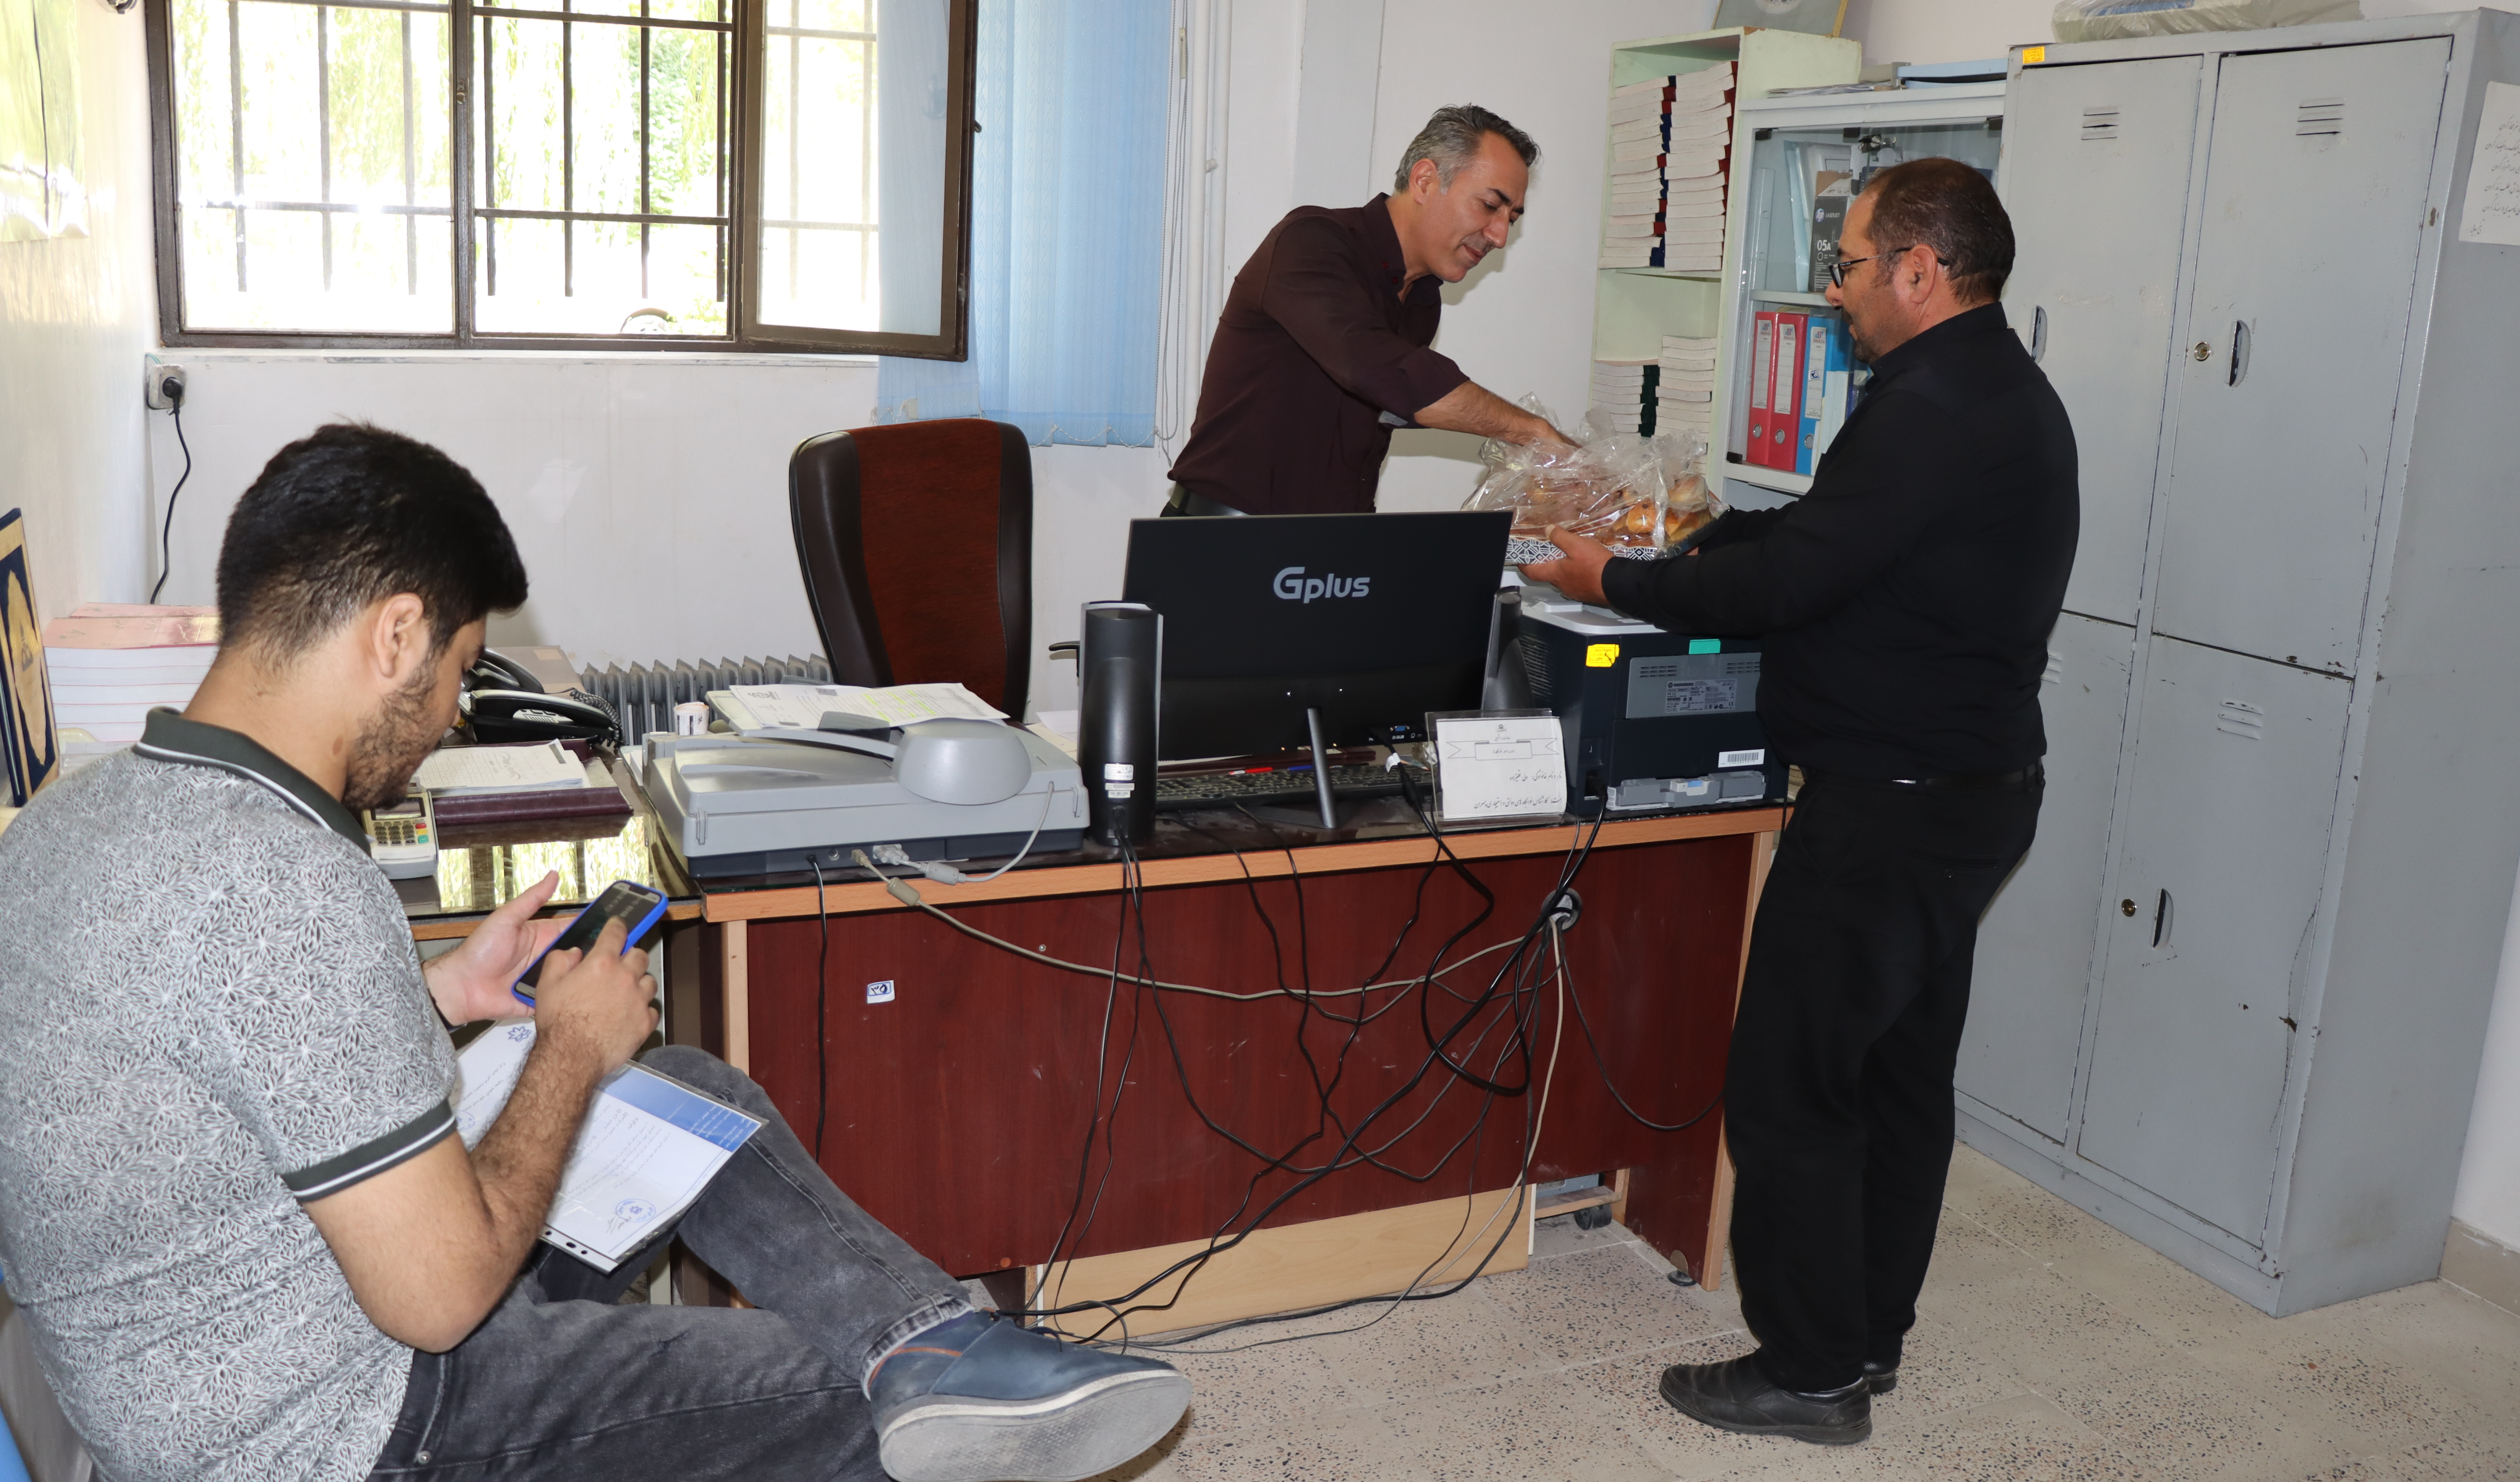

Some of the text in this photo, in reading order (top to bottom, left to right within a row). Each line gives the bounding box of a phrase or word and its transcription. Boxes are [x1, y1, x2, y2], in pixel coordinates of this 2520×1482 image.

[1815, 210, 1824, 222] hp
[1817, 240, 1831, 251] 05A
[1273, 567, 1370, 603] Gplus
[1533, 795, 1550, 806] کارشناس
